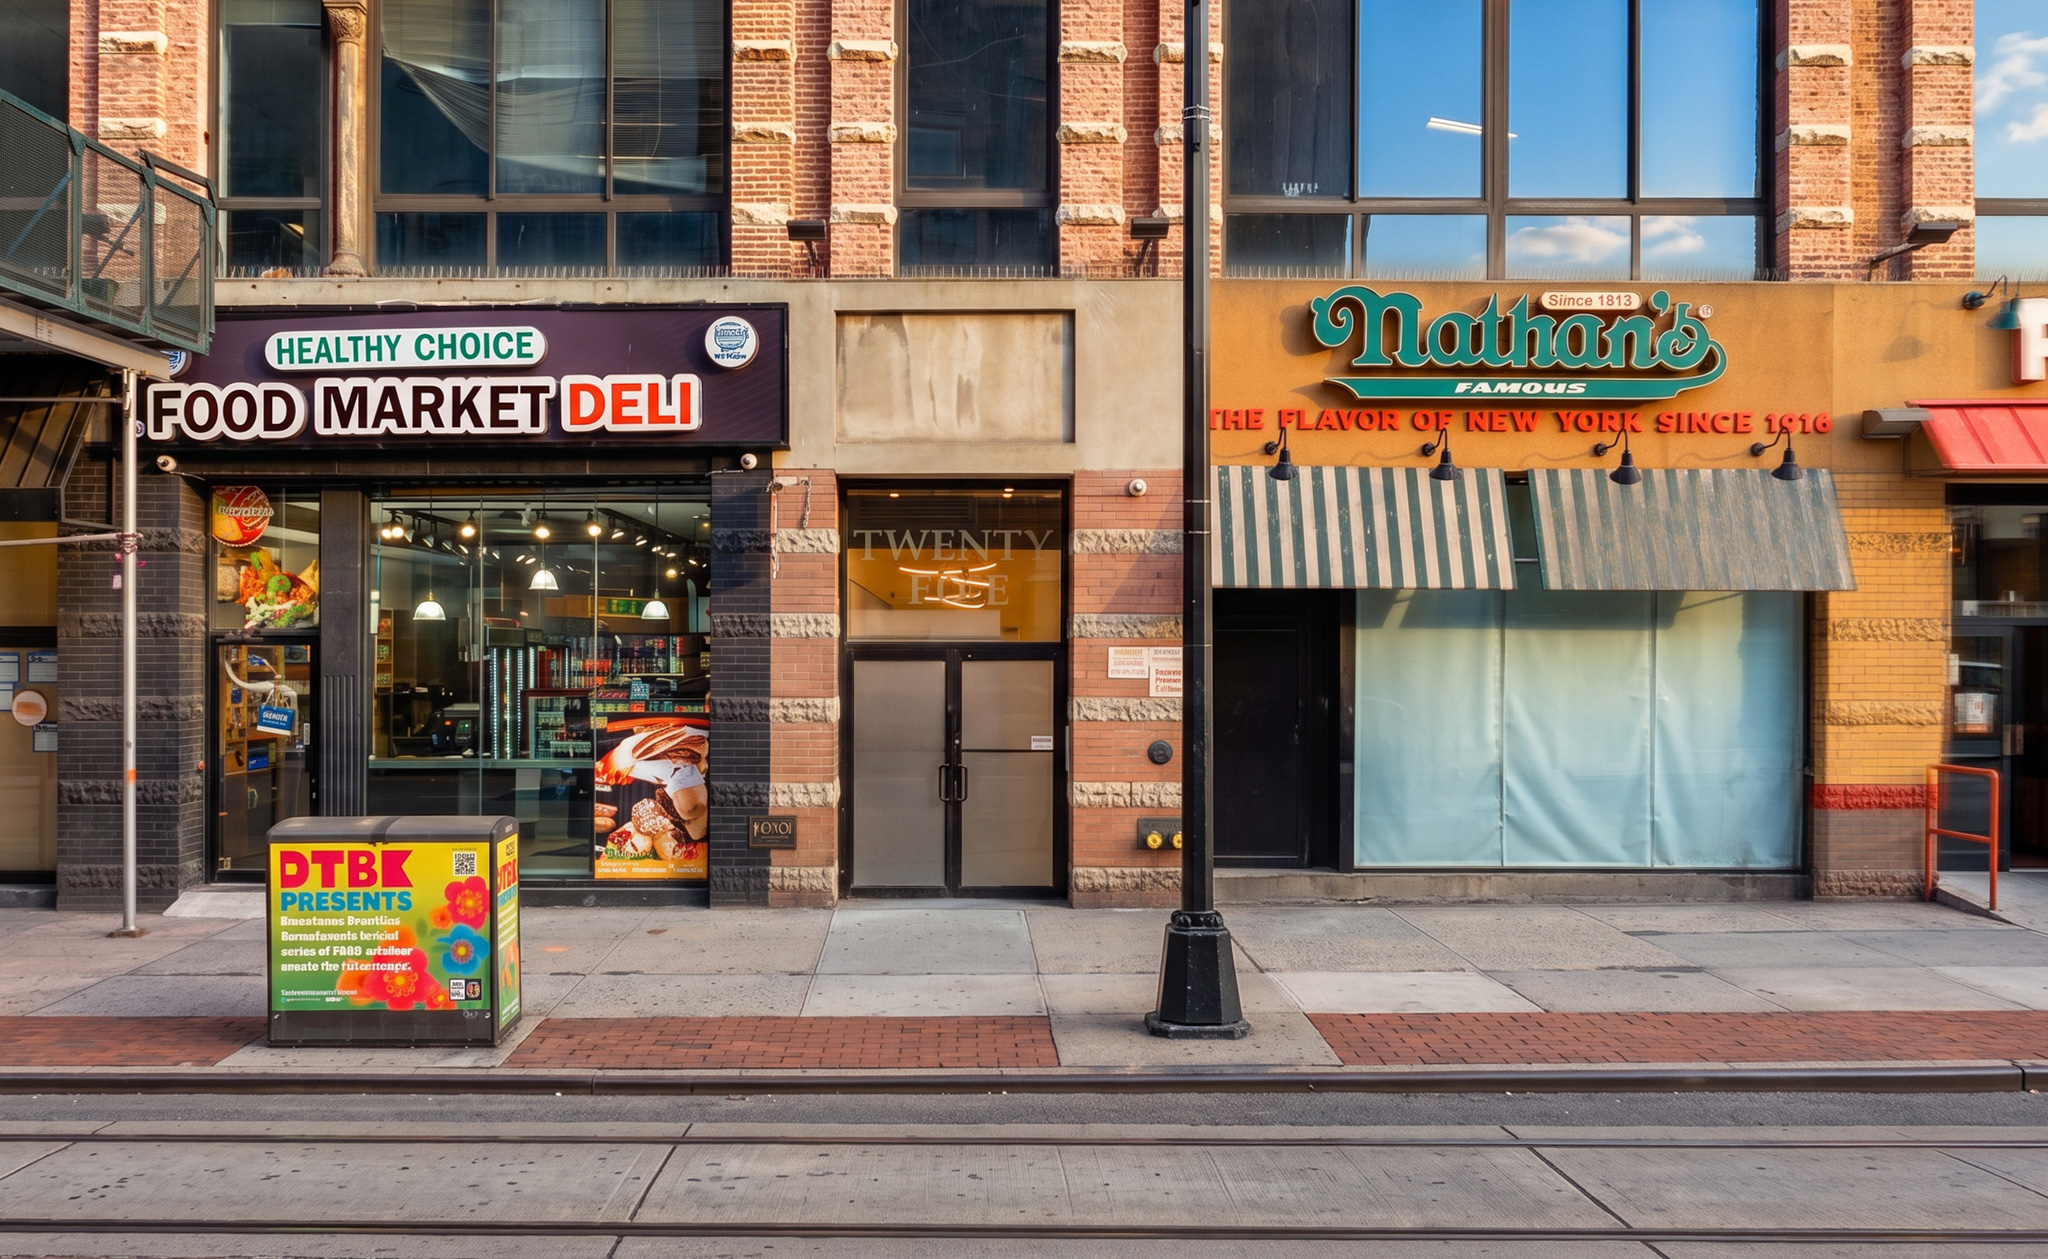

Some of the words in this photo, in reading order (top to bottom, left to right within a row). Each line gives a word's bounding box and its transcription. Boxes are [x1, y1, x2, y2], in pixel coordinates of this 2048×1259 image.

[1598, 294, 1632, 307] 1813
[1311, 286, 1722, 370] Nathan's
[276, 334, 402, 365] HEALTHY
[414, 332, 534, 361] CHOICE
[1454, 382, 1587, 395] FAMOUS
[152, 389, 296, 433] FOOD
[323, 385, 550, 430] MARKET
[569, 382, 691, 426] DELI
[1210, 409, 1264, 430] THE
[1279, 409, 1400, 430] FLAVOR
[1413, 409, 1453, 431] OF
[1466, 410, 1541, 432] NEW
[1556, 411, 1643, 433] YORK
[1656, 411, 1754, 433] SINCE
[1764, 411, 1833, 434] 1916
[853, 529, 1054, 561] TWENTY
[280, 850, 413, 888] DTBK
[281, 891, 412, 911] PRESENTS
[281, 946, 316, 957] series
[318, 946, 330, 957] of
